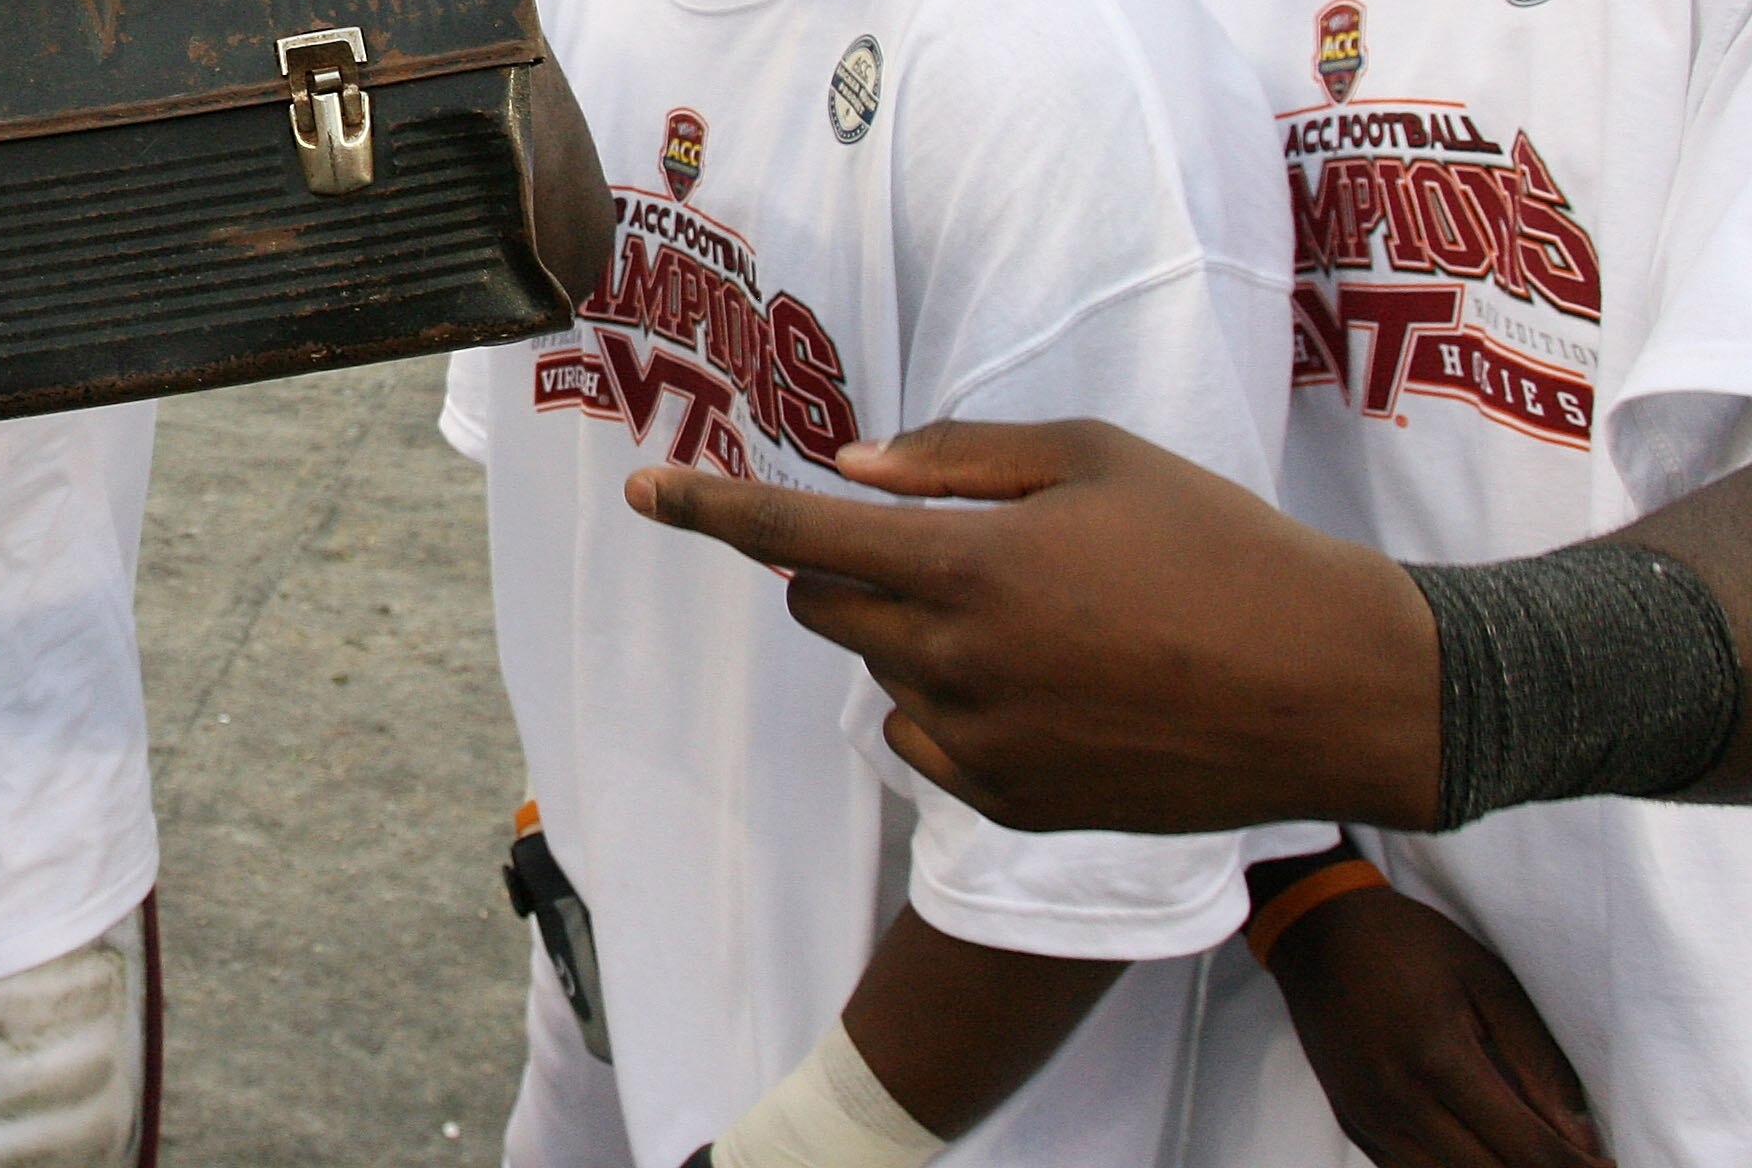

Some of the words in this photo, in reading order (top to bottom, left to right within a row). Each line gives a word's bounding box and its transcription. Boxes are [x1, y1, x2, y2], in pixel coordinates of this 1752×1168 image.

[1319, 29, 1361, 61] ACC
[666, 137, 704, 167] ACC
[1284, 120, 1332, 158] ACC
[1336, 112, 1503, 155] FOOTBALL
[629, 199, 672, 239] ACC
[673, 211, 762, 304] FOOTBALL
[1288, 128, 1602, 327] MPIONS
[578, 234, 862, 472] MPIONS
[592, 326, 735, 472] VT
